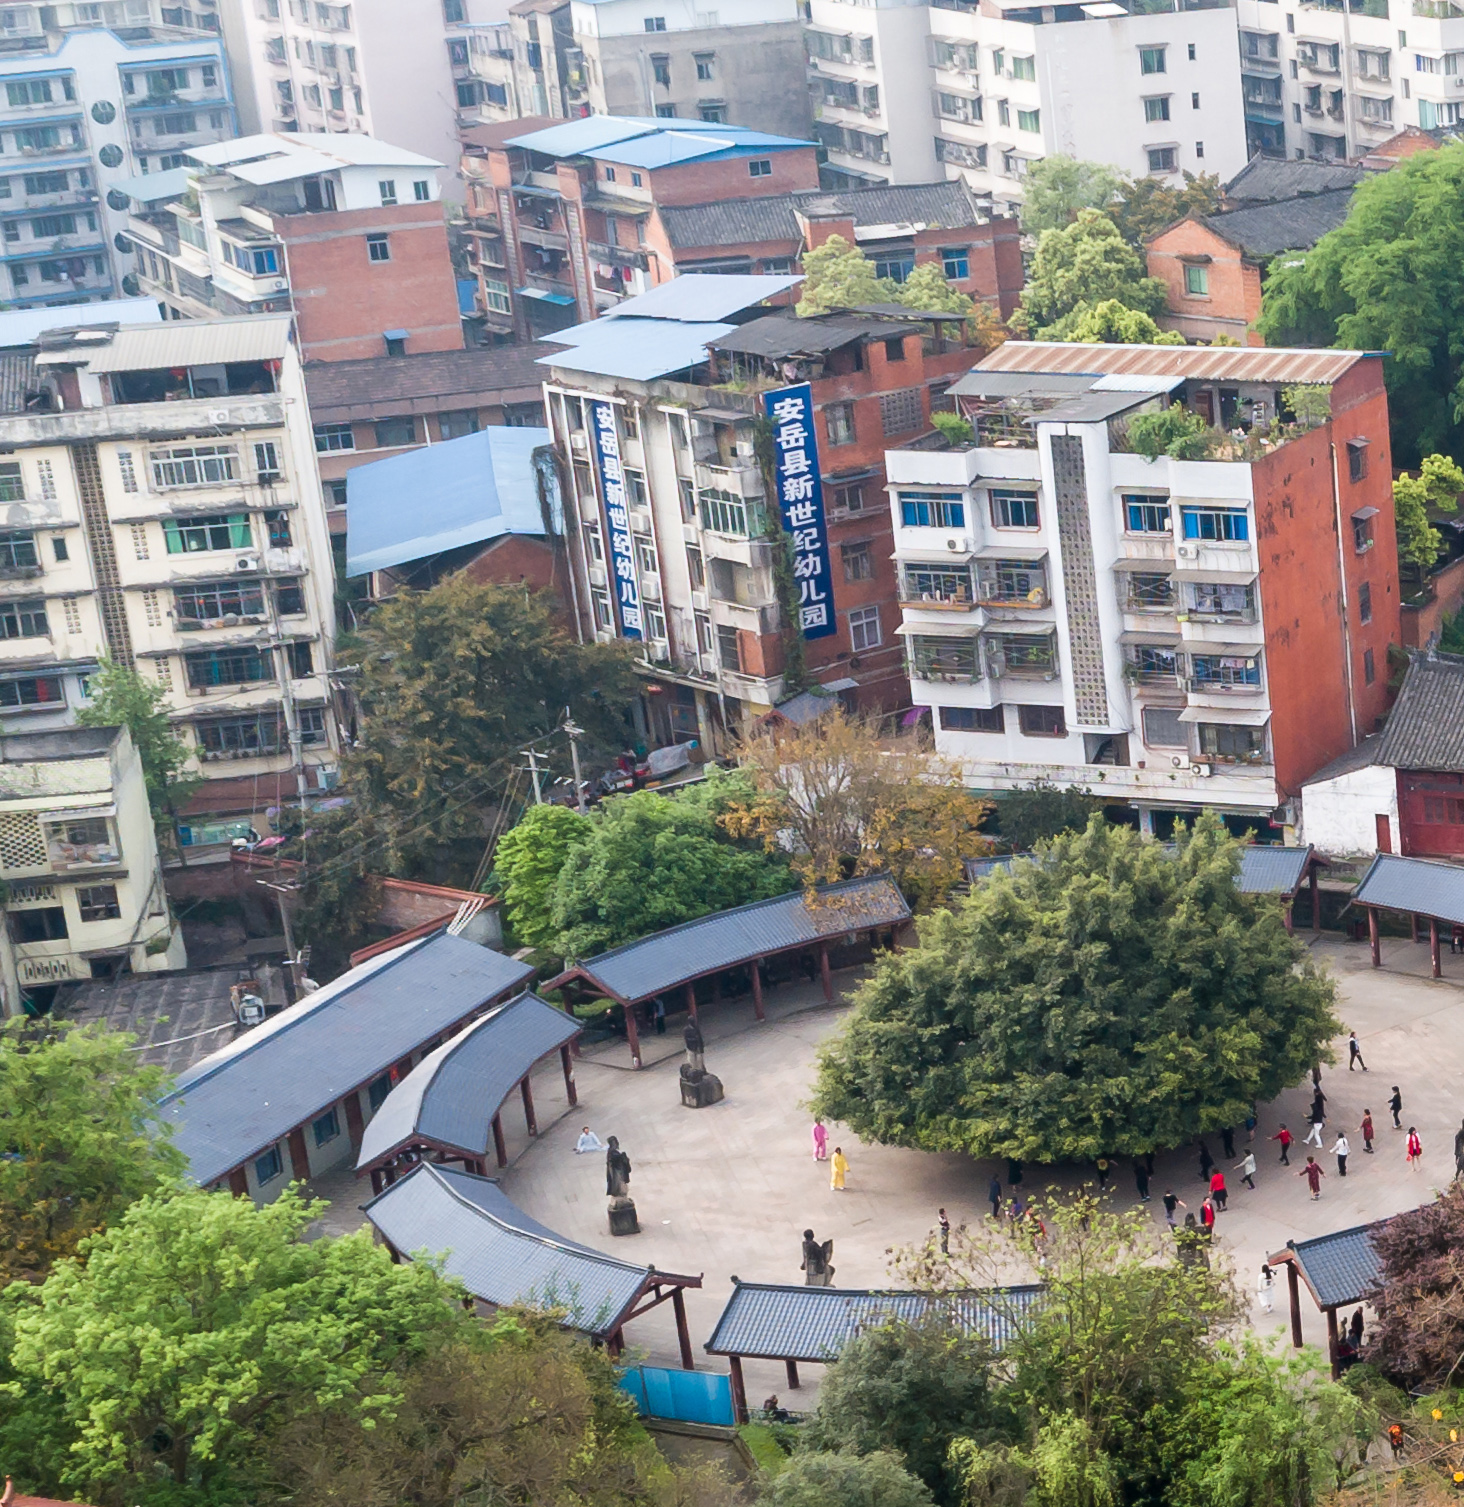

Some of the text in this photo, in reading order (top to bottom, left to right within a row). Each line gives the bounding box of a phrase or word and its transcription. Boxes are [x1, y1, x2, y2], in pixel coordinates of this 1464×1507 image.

[596, 405, 642, 629] 安岳县新世纪幼儿园
[773, 397, 829, 630] 安岳县新世纪幼儿园
